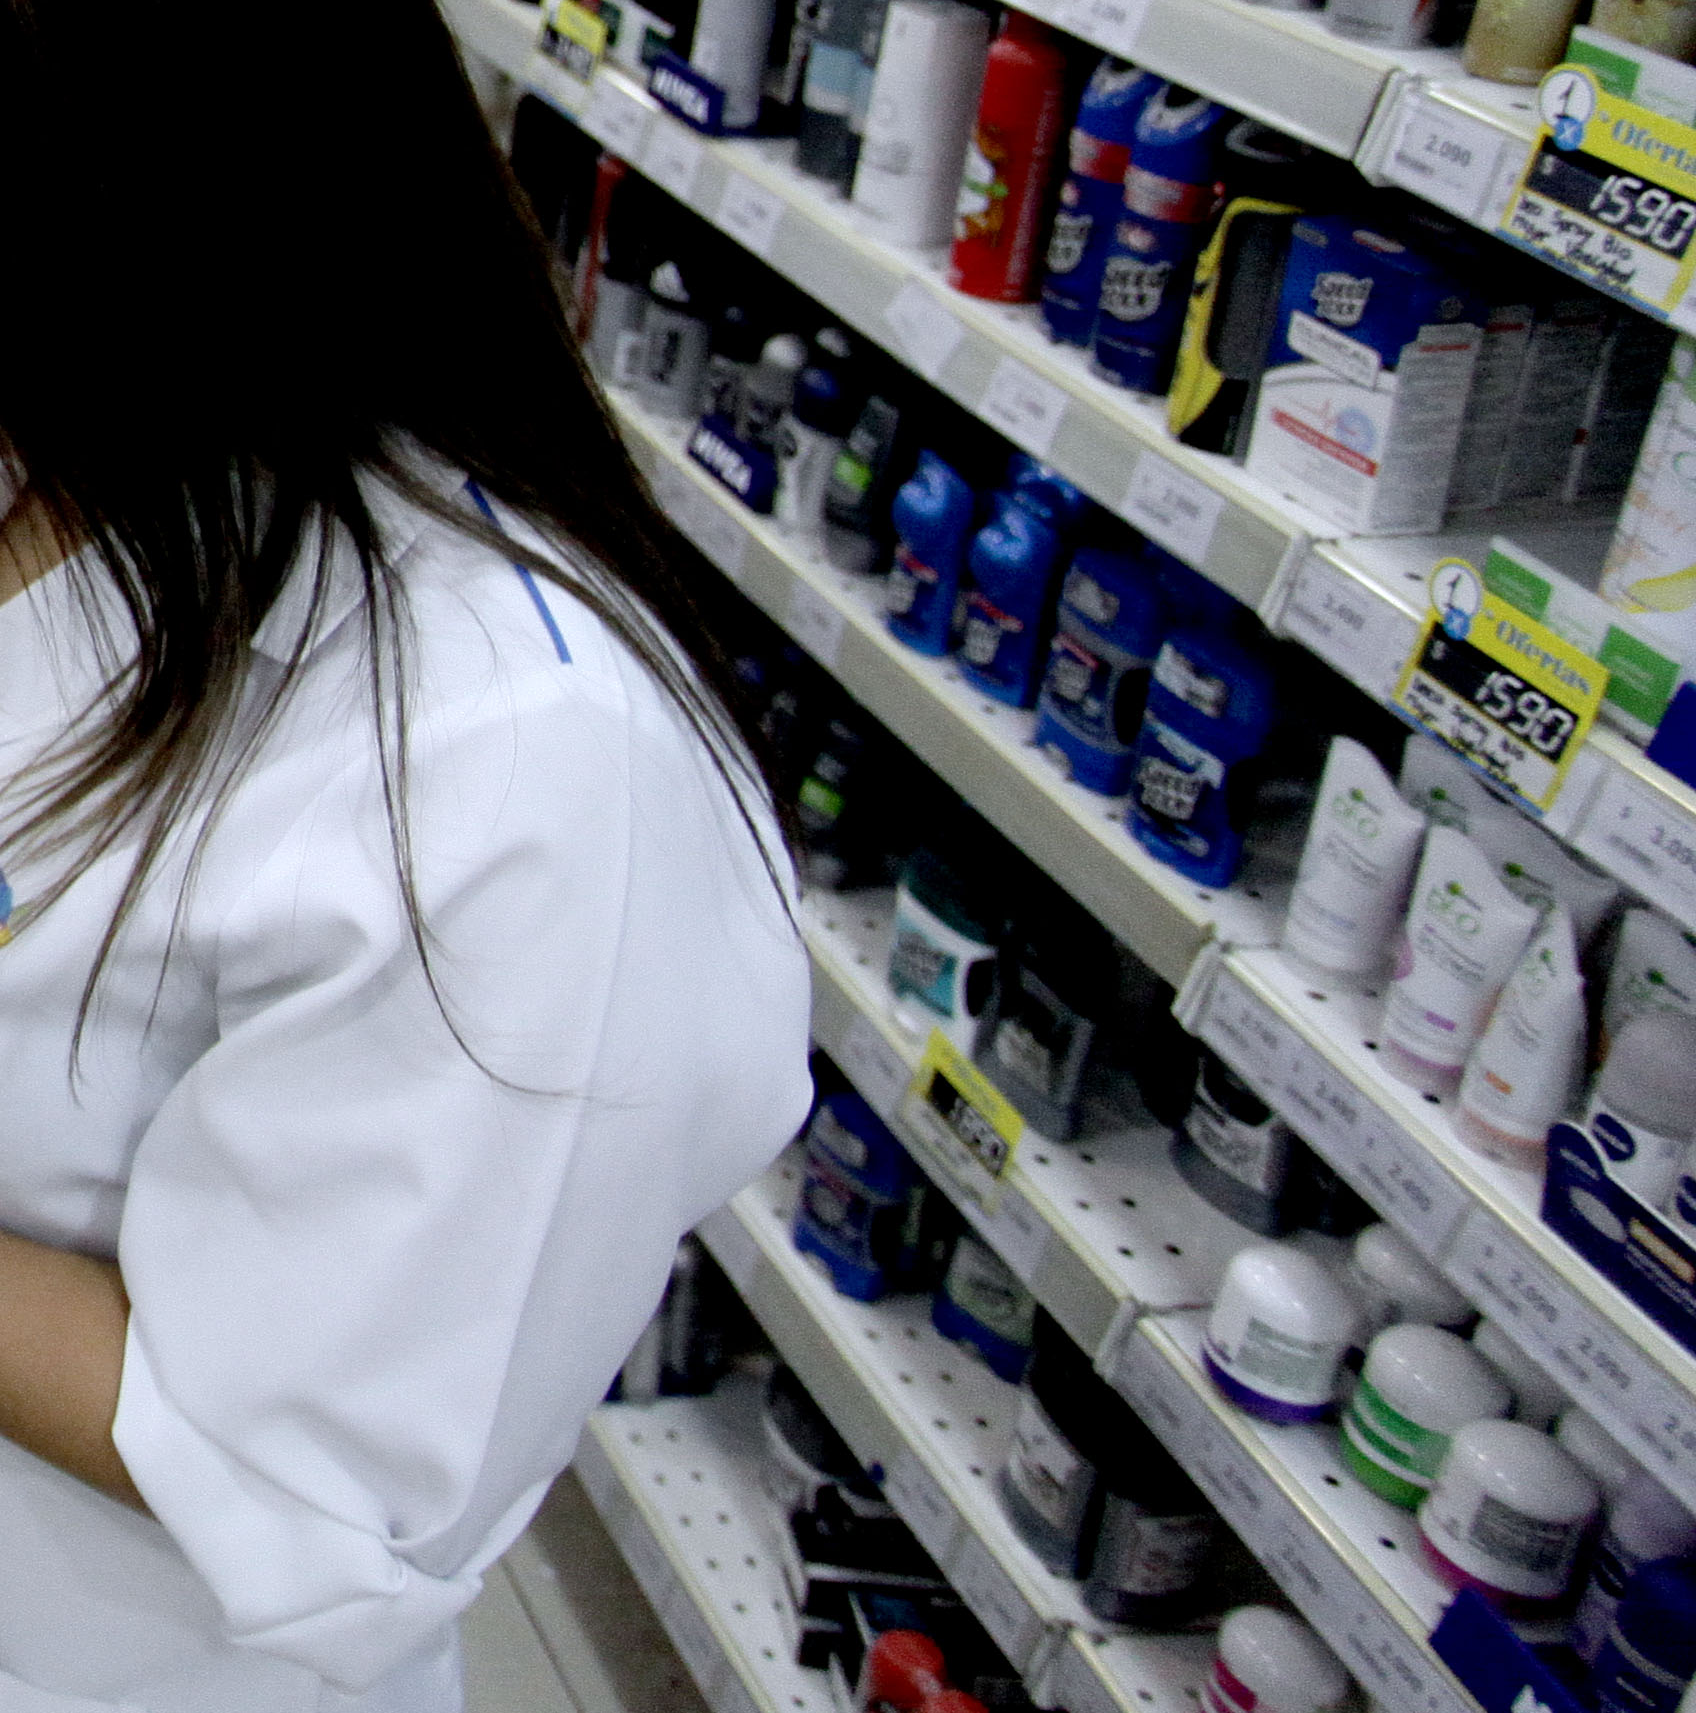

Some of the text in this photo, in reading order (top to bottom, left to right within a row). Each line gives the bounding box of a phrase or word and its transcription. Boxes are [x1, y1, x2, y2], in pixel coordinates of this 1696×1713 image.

[1612, 120, 1696, 177] Oferta
[1589, 173, 1695, 251] 1590
[695, 428, 754, 493] NIVEA
[1495, 619, 1591, 696] Ofertas
[1475, 670, 1574, 754] 1590
